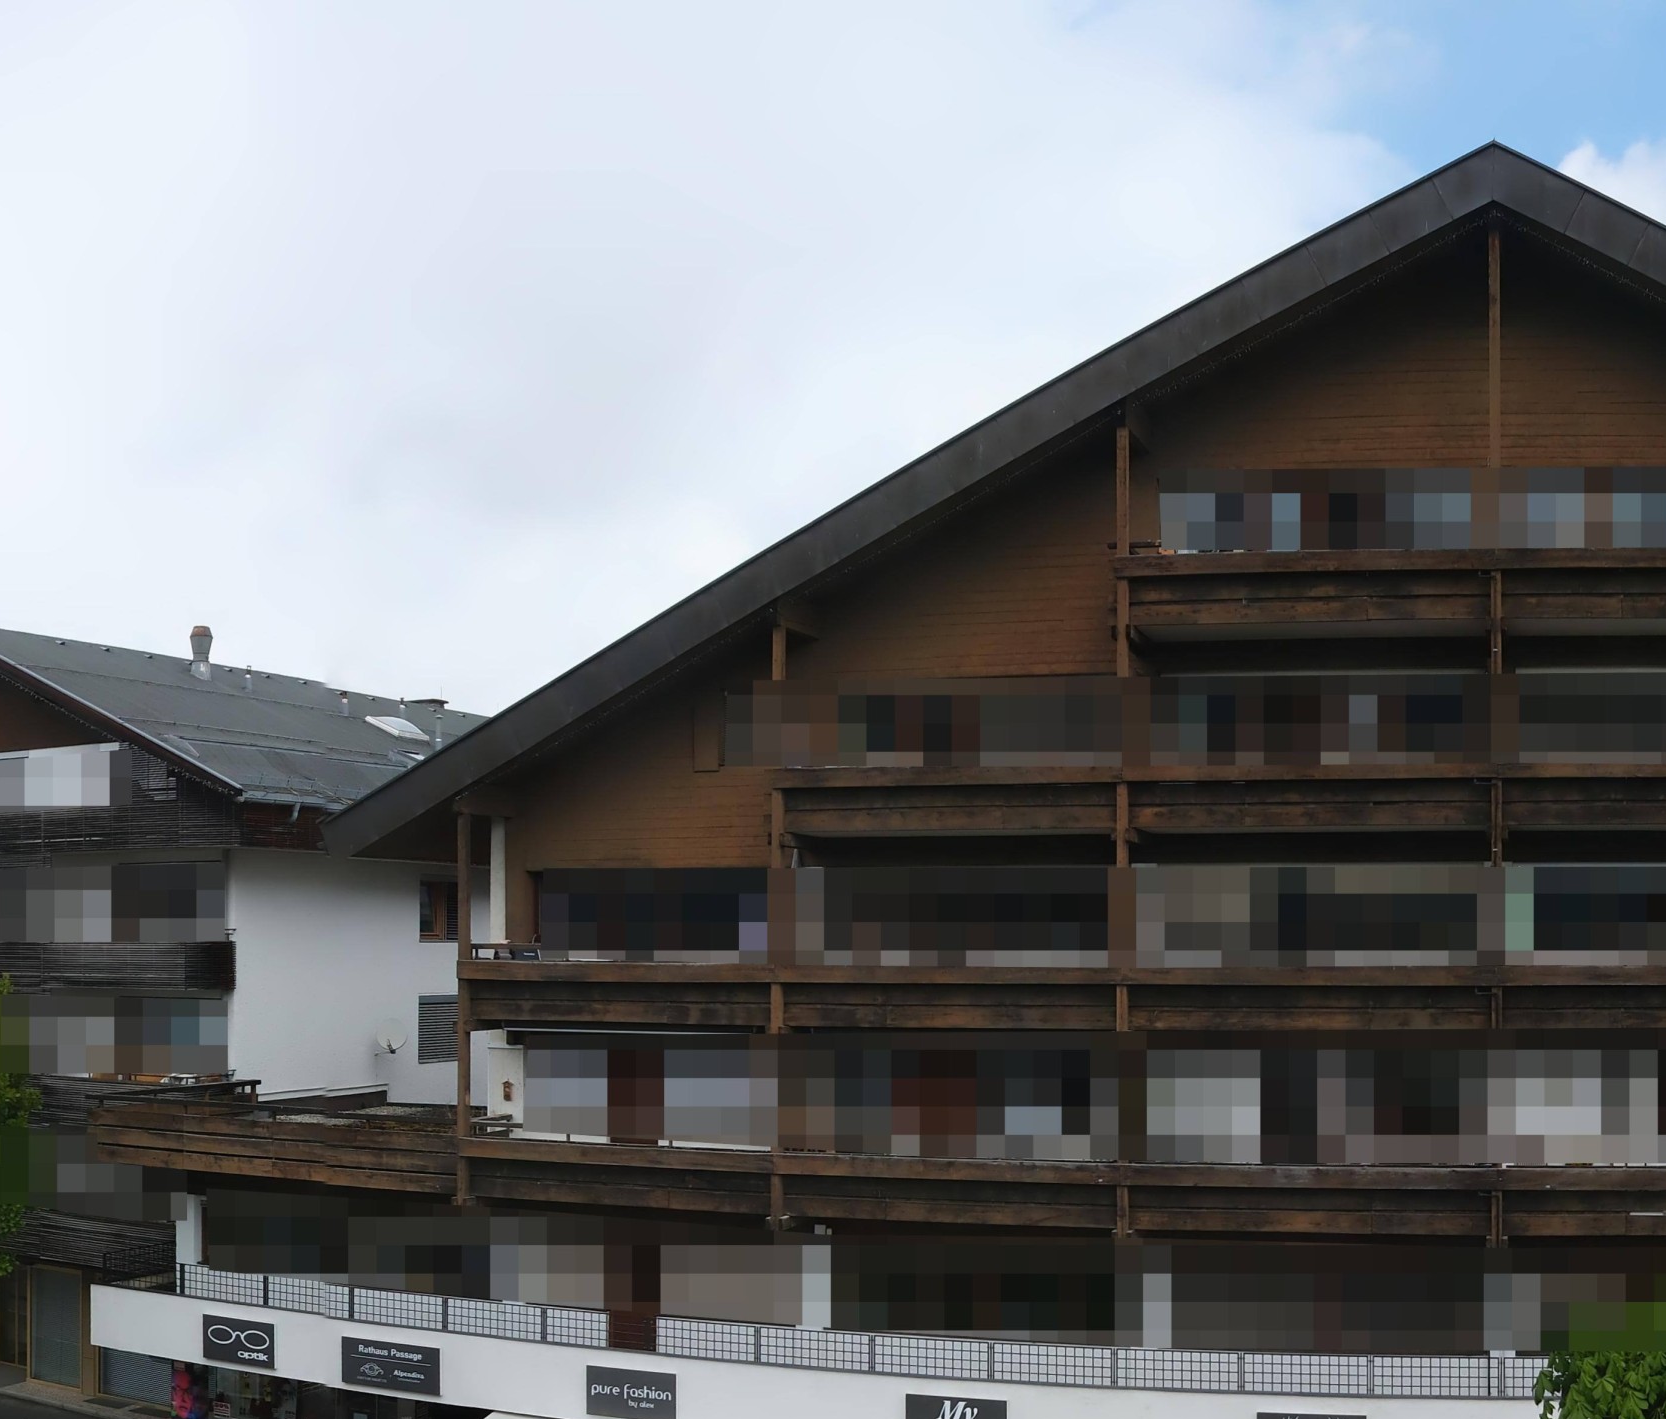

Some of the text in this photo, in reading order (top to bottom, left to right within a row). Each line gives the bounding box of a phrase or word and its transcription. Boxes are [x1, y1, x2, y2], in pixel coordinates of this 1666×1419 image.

[238, 1350, 269, 1362] optik
[358, 1344, 423, 1361] Rathaus Passage
[591, 1383, 672, 1401] pure fashion
[628, 1399, 638, 1408] by
